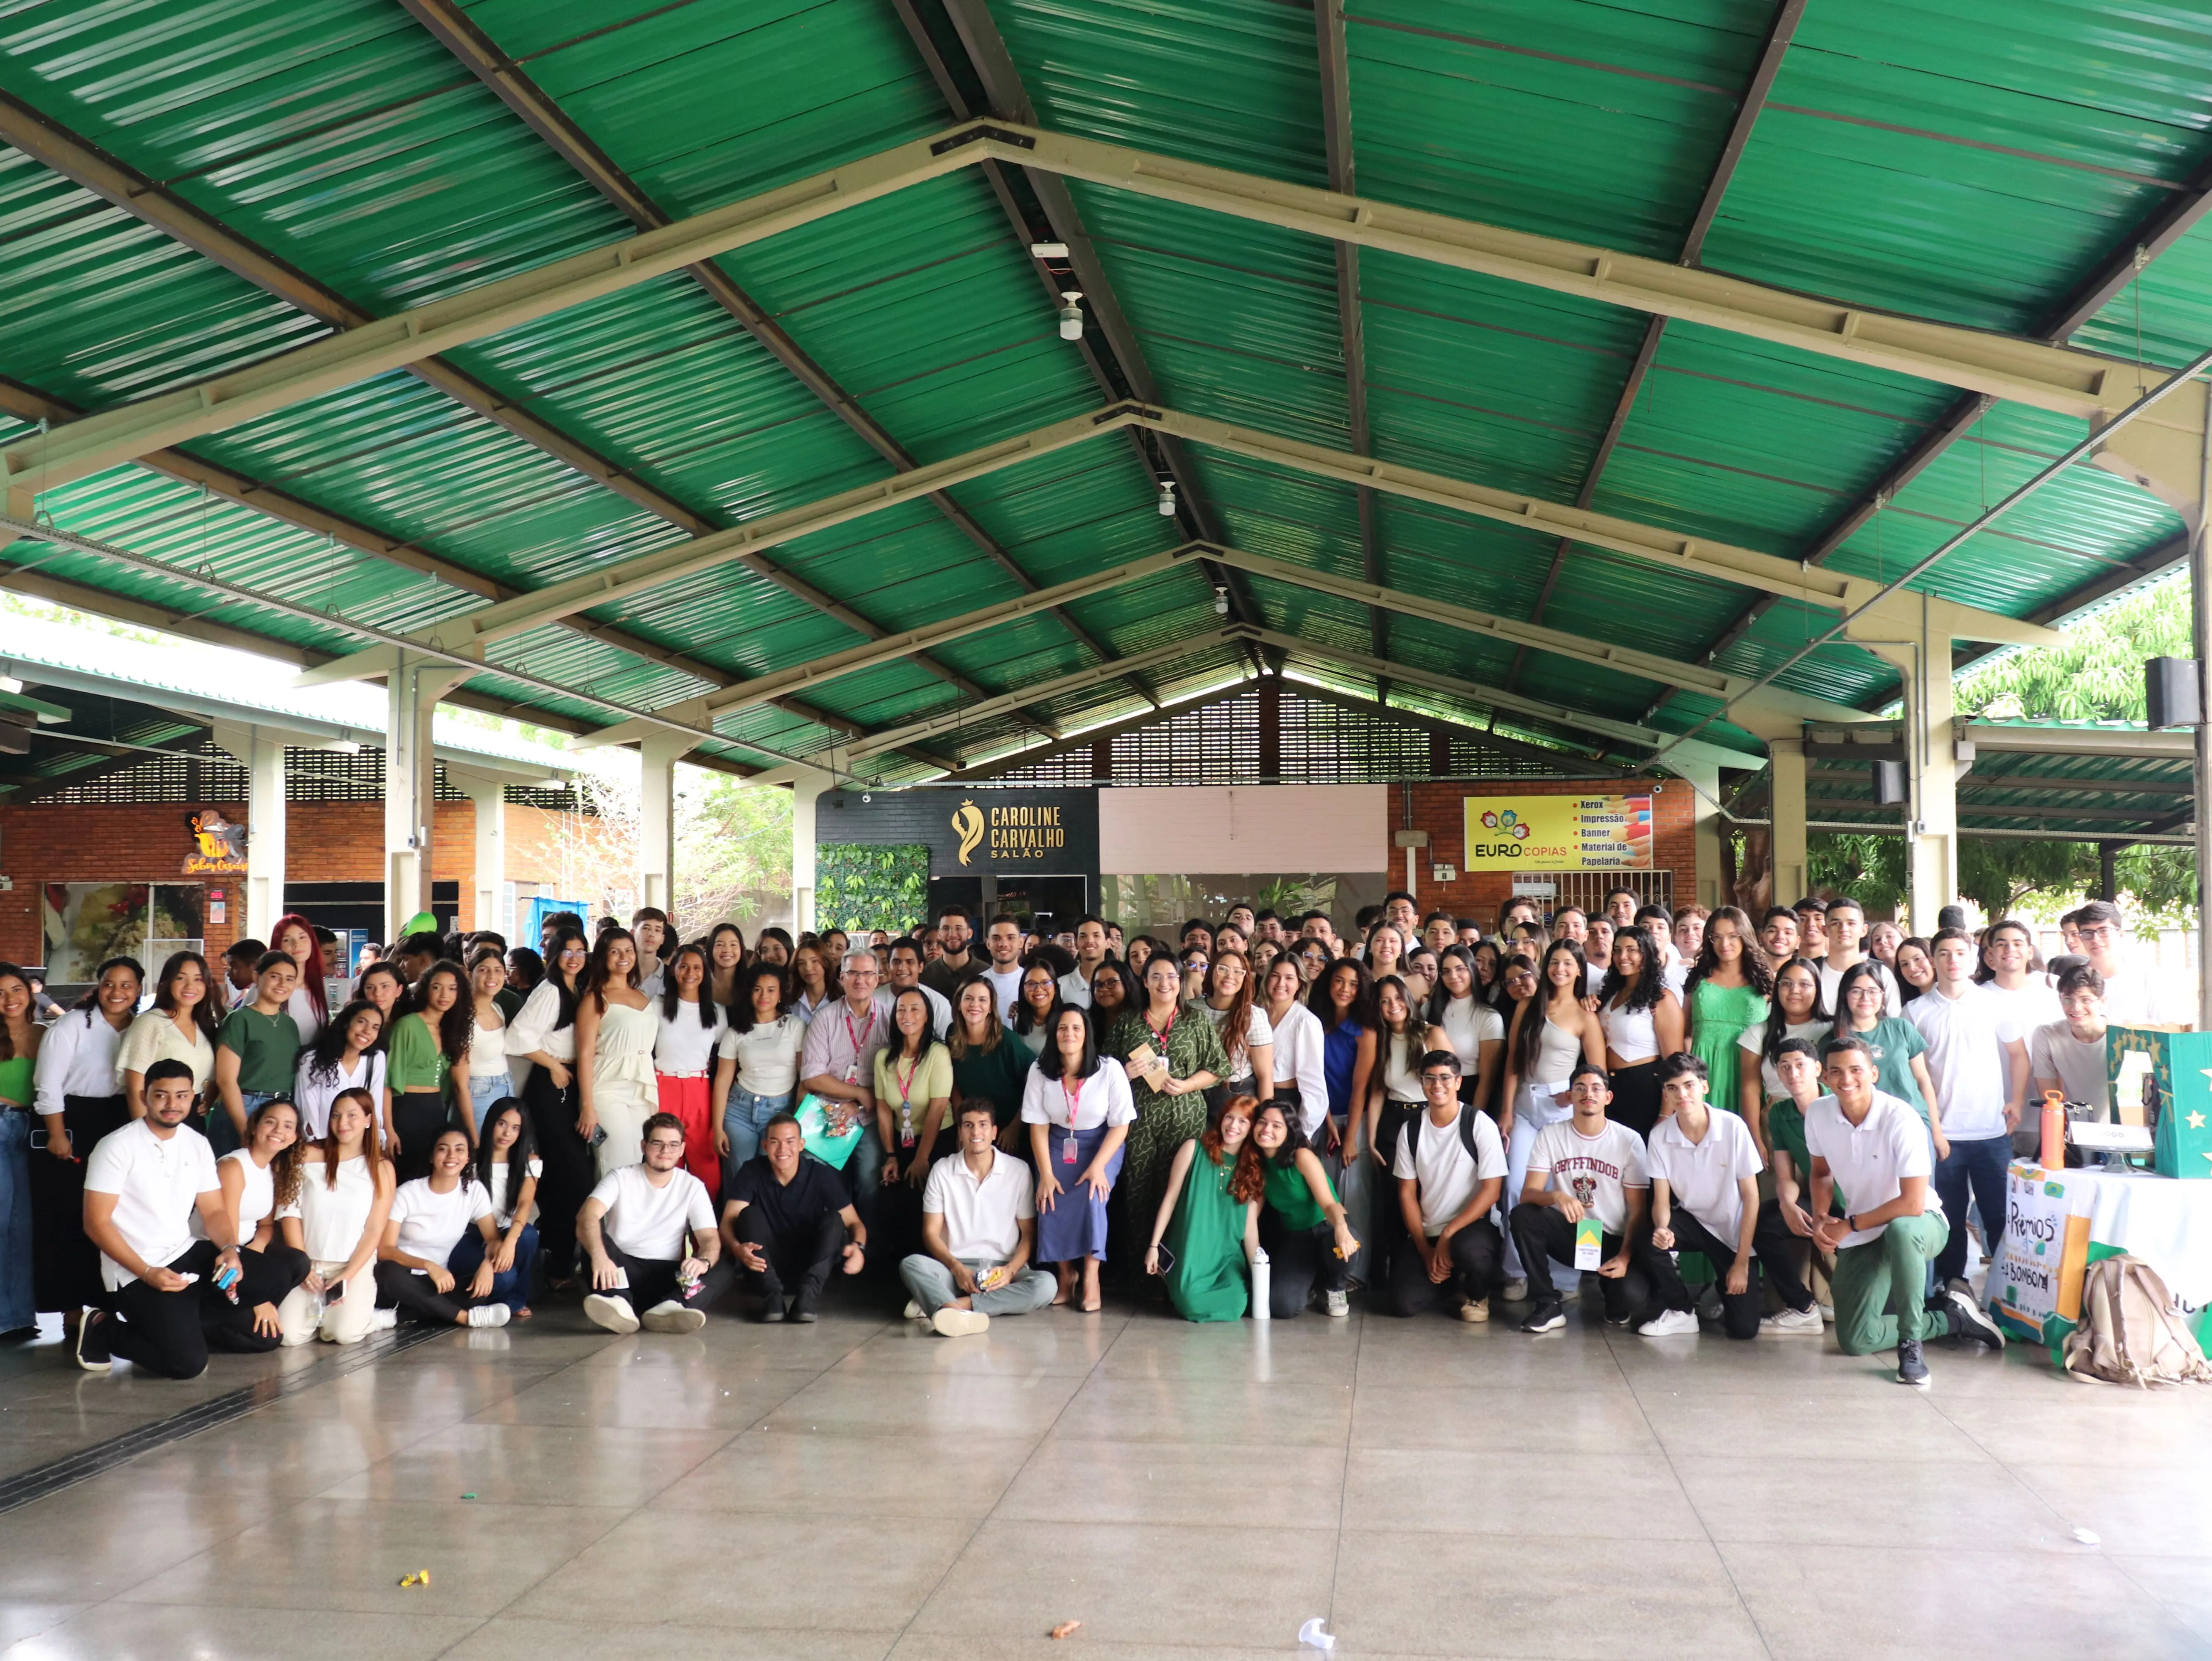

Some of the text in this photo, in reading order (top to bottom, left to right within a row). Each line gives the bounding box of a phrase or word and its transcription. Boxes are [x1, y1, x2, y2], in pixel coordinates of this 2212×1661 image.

[1581, 800, 1603, 809] Xerox
[991, 806, 1061, 826] CAROLINE
[1581, 814, 1624, 824] Impressão
[1581, 828, 1610, 837] Banner
[991, 828, 1064, 848] CARVALHO
[1581, 843, 1627, 851] Material de
[991, 848, 1044, 858] SALÃO
[1581, 857, 1620, 866] Papelaria
[1555, 1156, 1618, 1179] GRYFFINDOR
